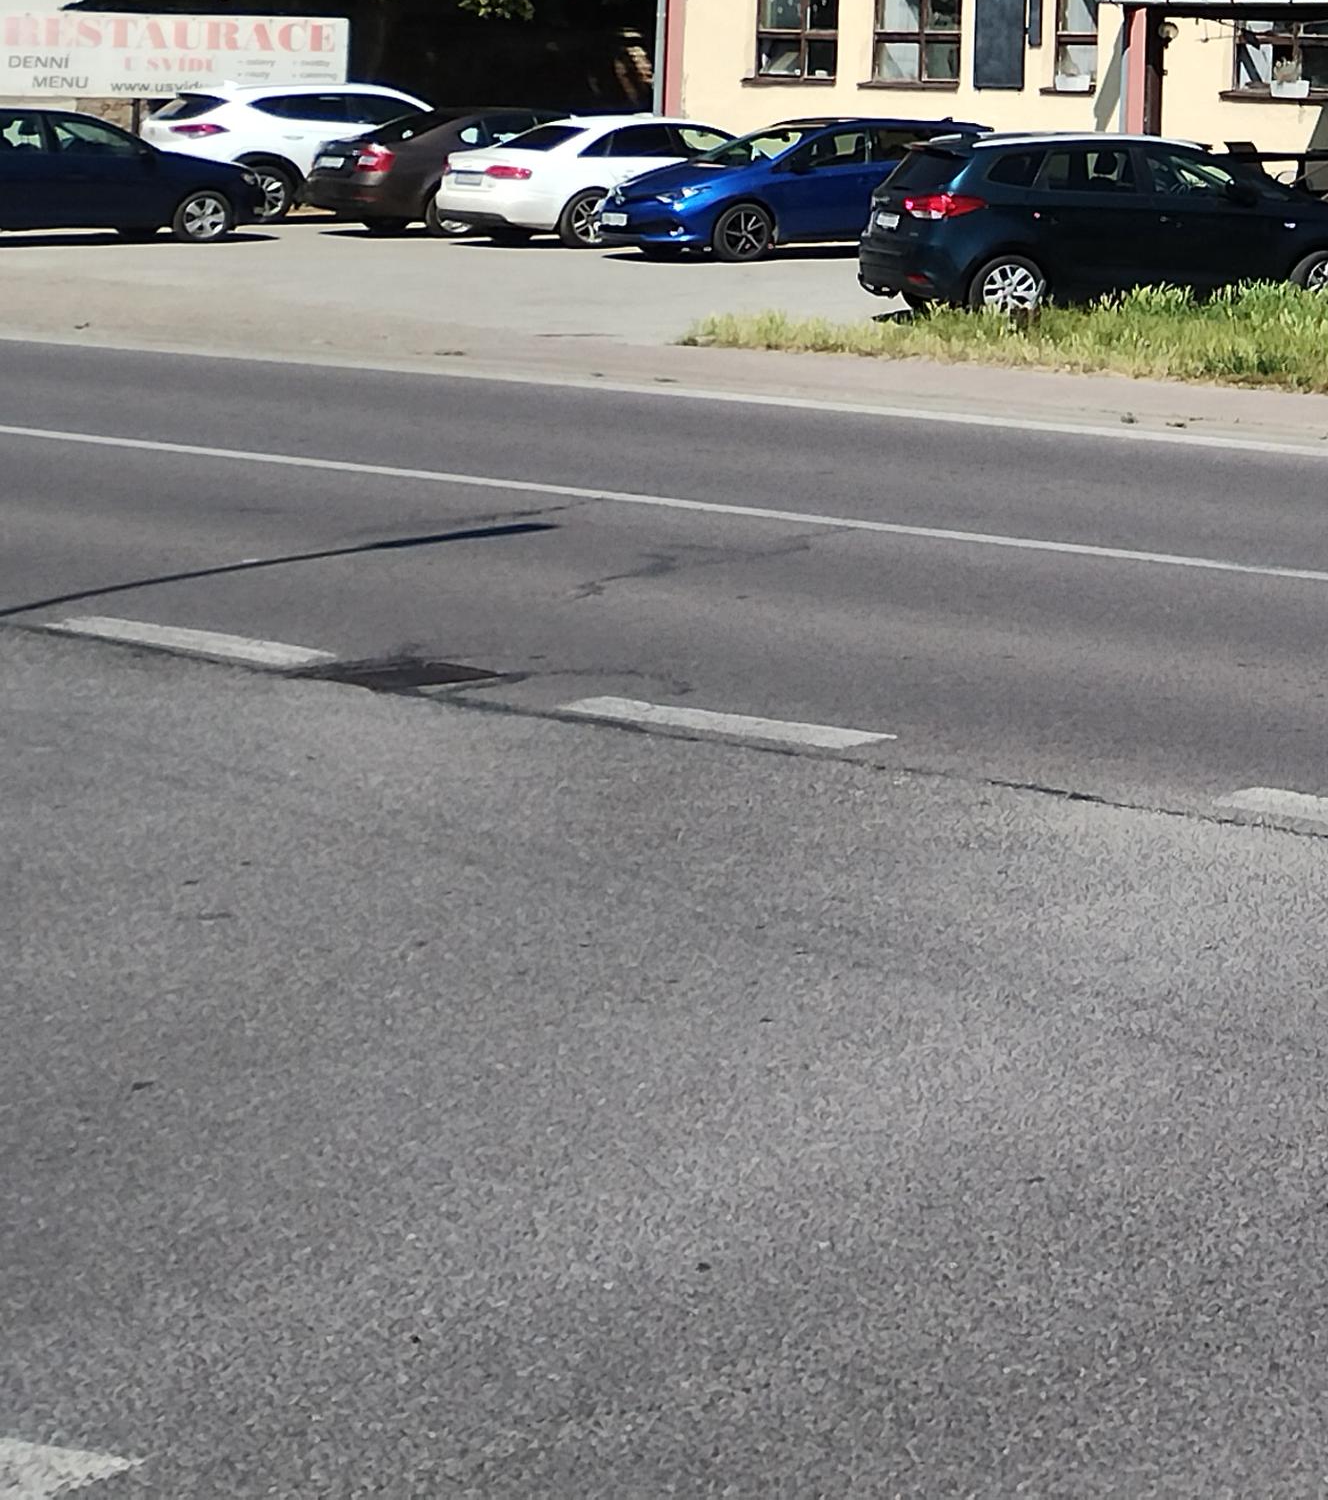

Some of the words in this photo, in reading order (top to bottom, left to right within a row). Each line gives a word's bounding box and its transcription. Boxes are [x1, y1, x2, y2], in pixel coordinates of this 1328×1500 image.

[4, 16, 336, 53] RESTAURACE
[8, 54, 70, 69] DENNÍ
[32, 76, 89, 89] MENU
